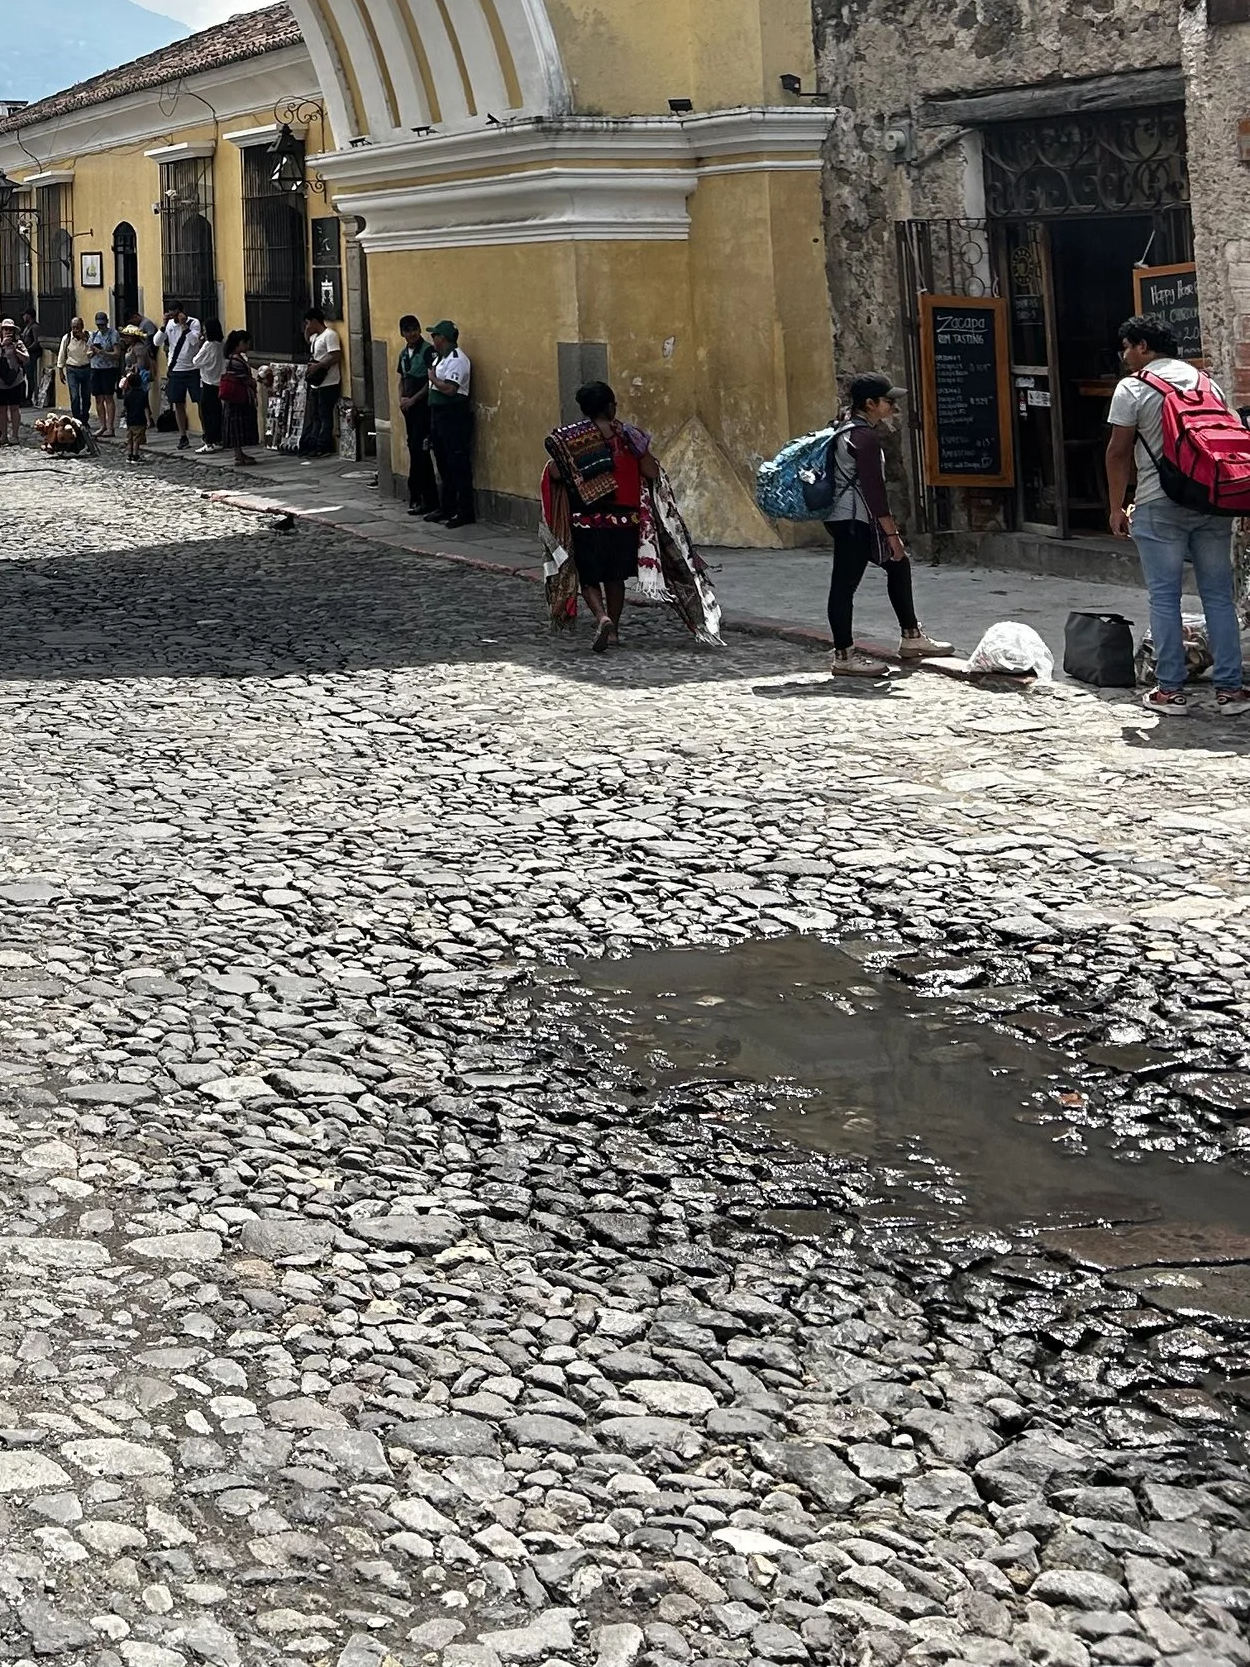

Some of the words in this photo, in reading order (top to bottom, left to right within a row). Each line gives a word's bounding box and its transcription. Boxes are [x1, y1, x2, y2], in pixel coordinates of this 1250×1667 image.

[1150, 285, 1175, 306] Happy
[936, 315, 986, 334] Zacapa
[953, 334, 985, 344] TASTING
